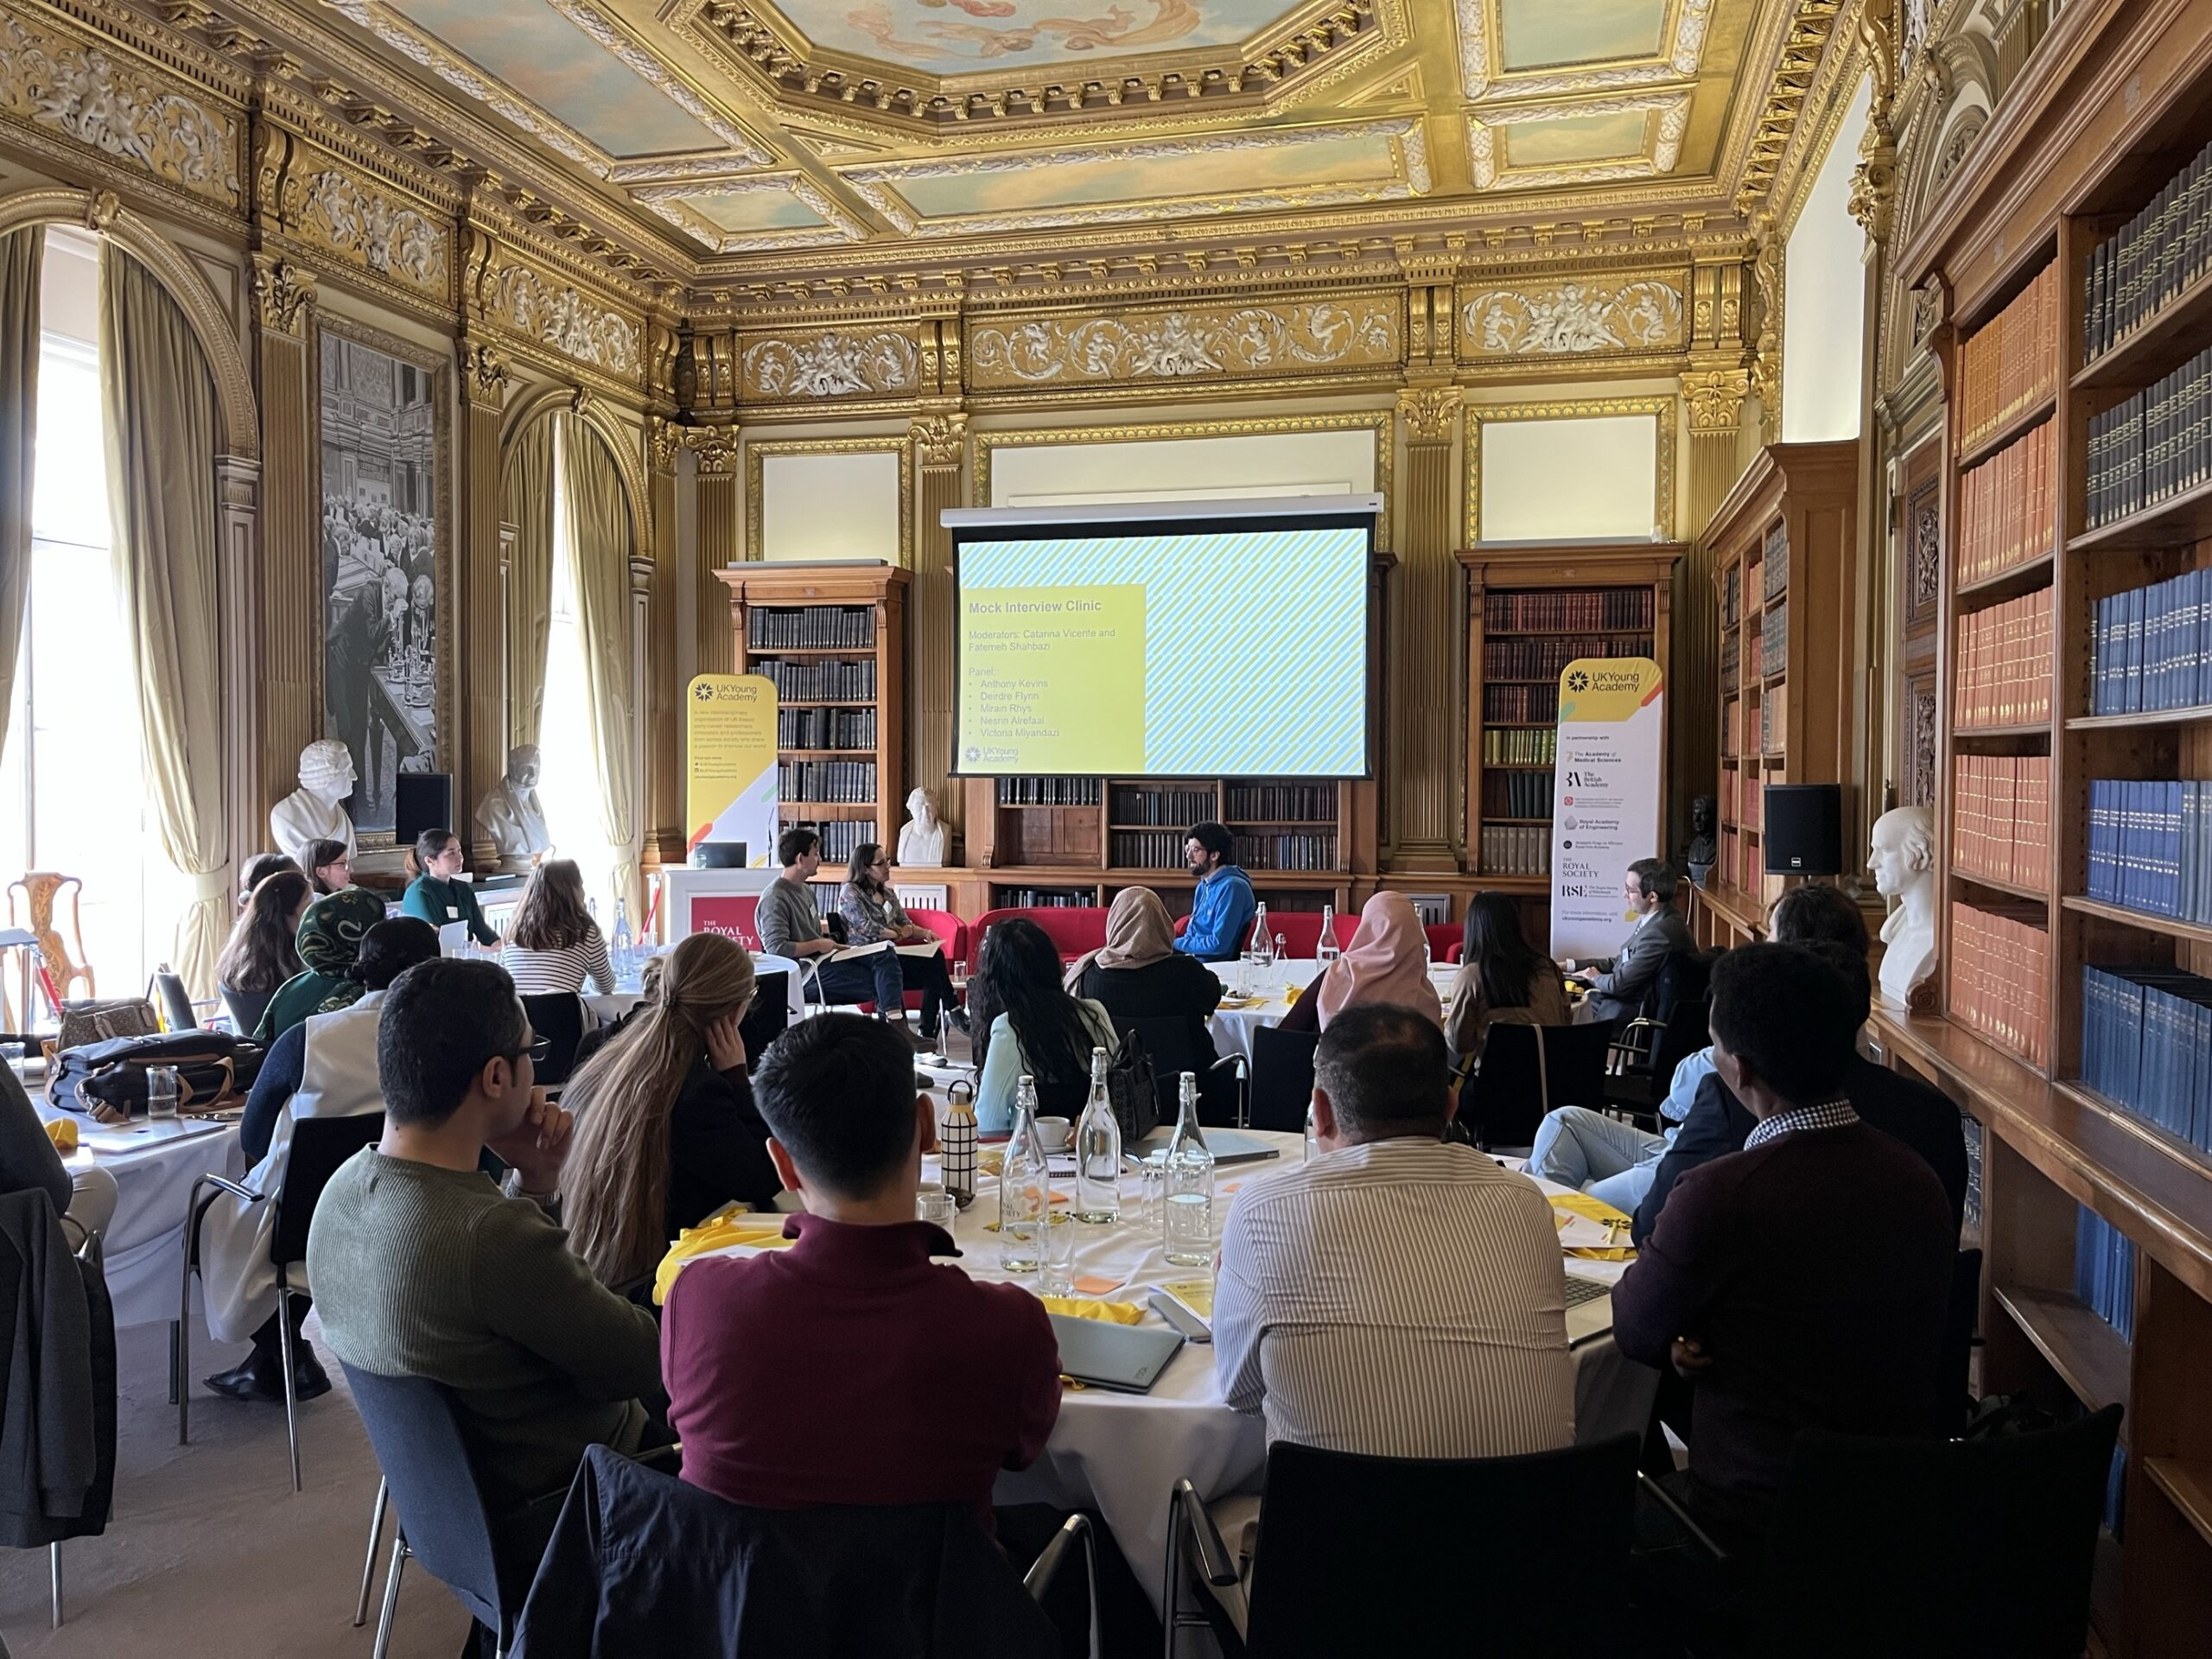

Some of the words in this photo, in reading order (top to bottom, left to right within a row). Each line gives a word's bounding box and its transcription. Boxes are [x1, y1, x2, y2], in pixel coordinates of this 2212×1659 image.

[969, 602, 1001, 613] Mock
[1006, 601, 1062, 613] Interview
[1066, 600, 1102, 611] Clinic
[969, 630, 1020, 639] Moderators:
[1063, 629, 1096, 638] Vicente
[969, 643, 1007, 652] Fatemeh
[1009, 642, 1051, 651] Shahbazi
[968, 668, 996, 677] Panel:
[980, 680, 1016, 690] Anthony
[1019, 679, 1048, 688] Kevins
[1592, 683, 1639, 692] Academy
[716, 693, 758, 702] Academy
[980, 692, 1013, 701] Deirdre
[1015, 692, 1039, 702] Flynn
[1009, 704, 1033, 714] Rhys
[980, 728, 1013, 737] Victoria
[1015, 728, 1059, 739] Miyandazi
[982, 754, 1019, 763] Academy
[1562, 885, 1587, 898] RSE
[703, 926, 742, 936] ROYAL
